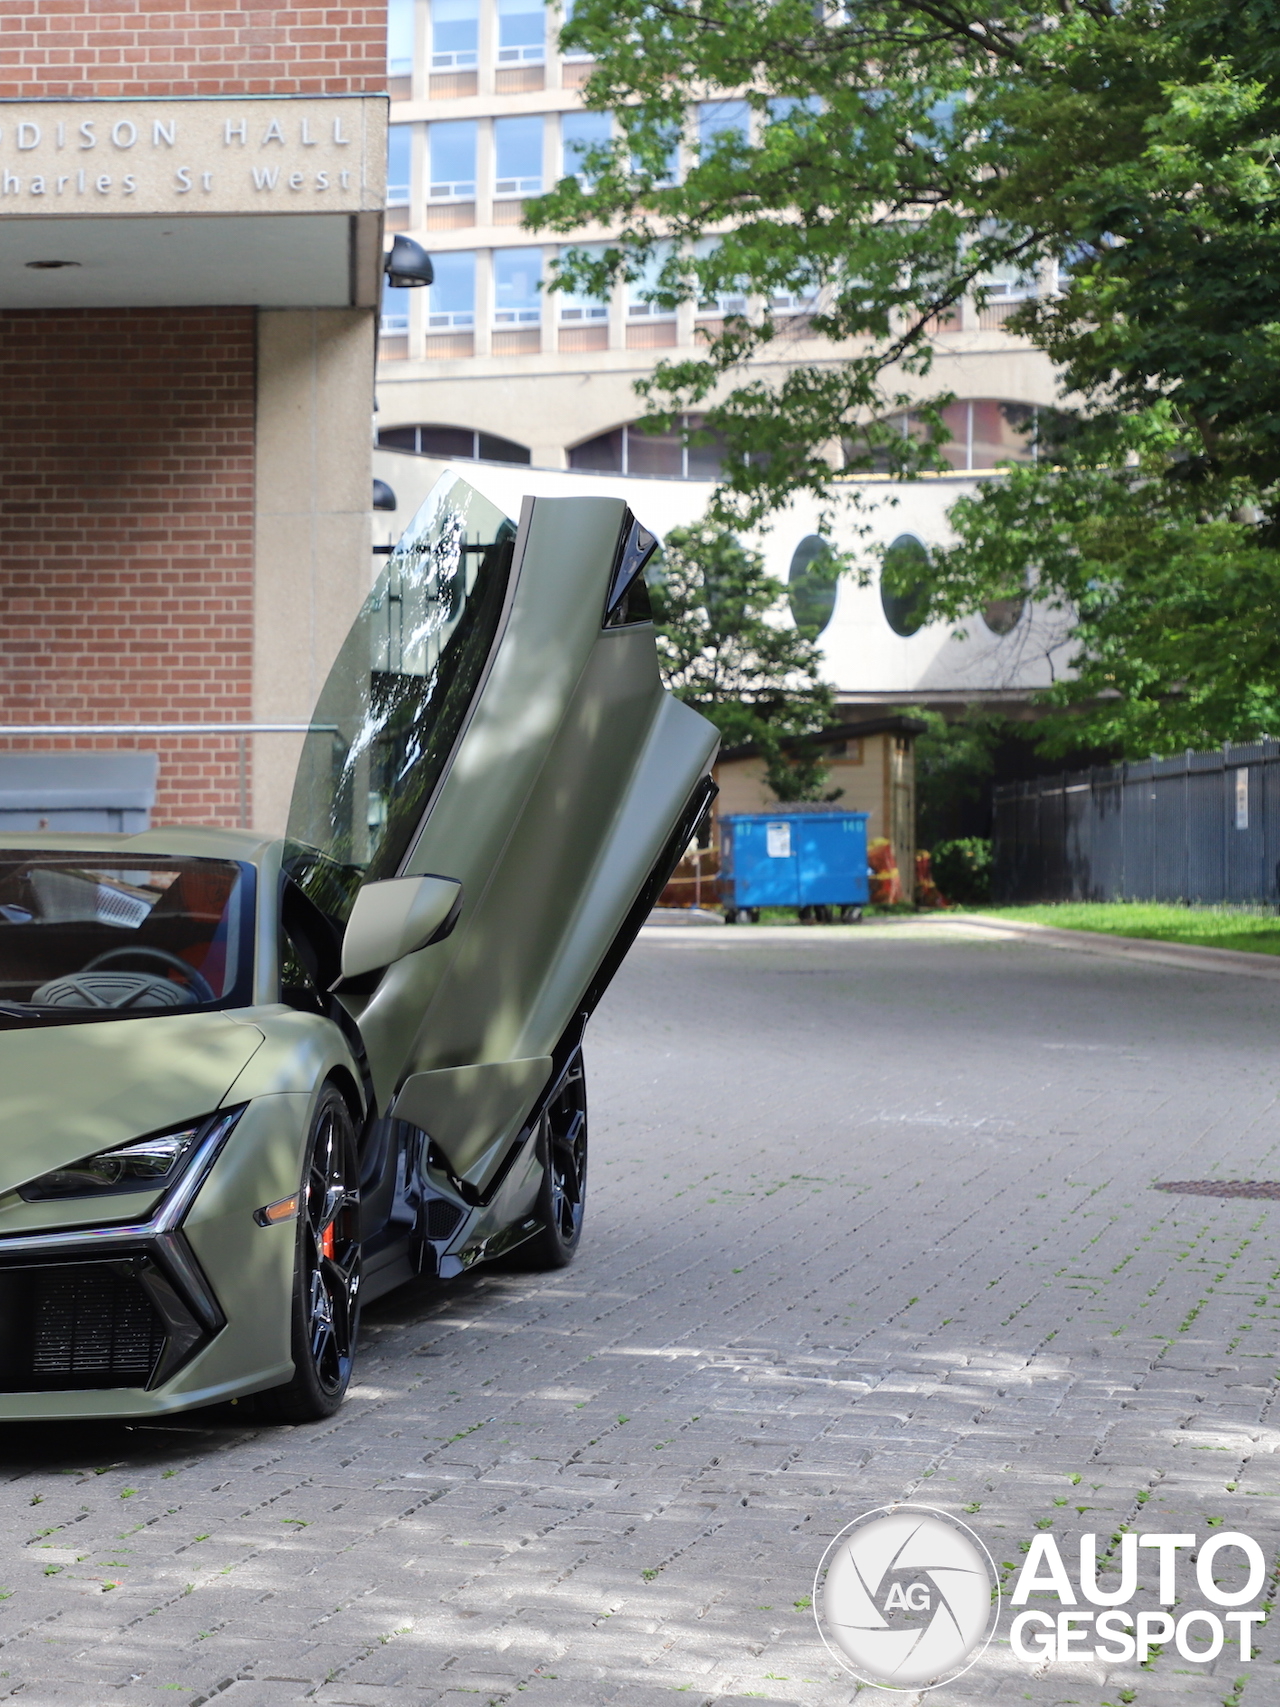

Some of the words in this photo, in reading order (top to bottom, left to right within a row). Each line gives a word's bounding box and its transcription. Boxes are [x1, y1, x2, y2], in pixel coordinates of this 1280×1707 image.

[224, 117, 350, 146] HALL
[176, 166, 213, 193] St
[252, 165, 352, 191] West
